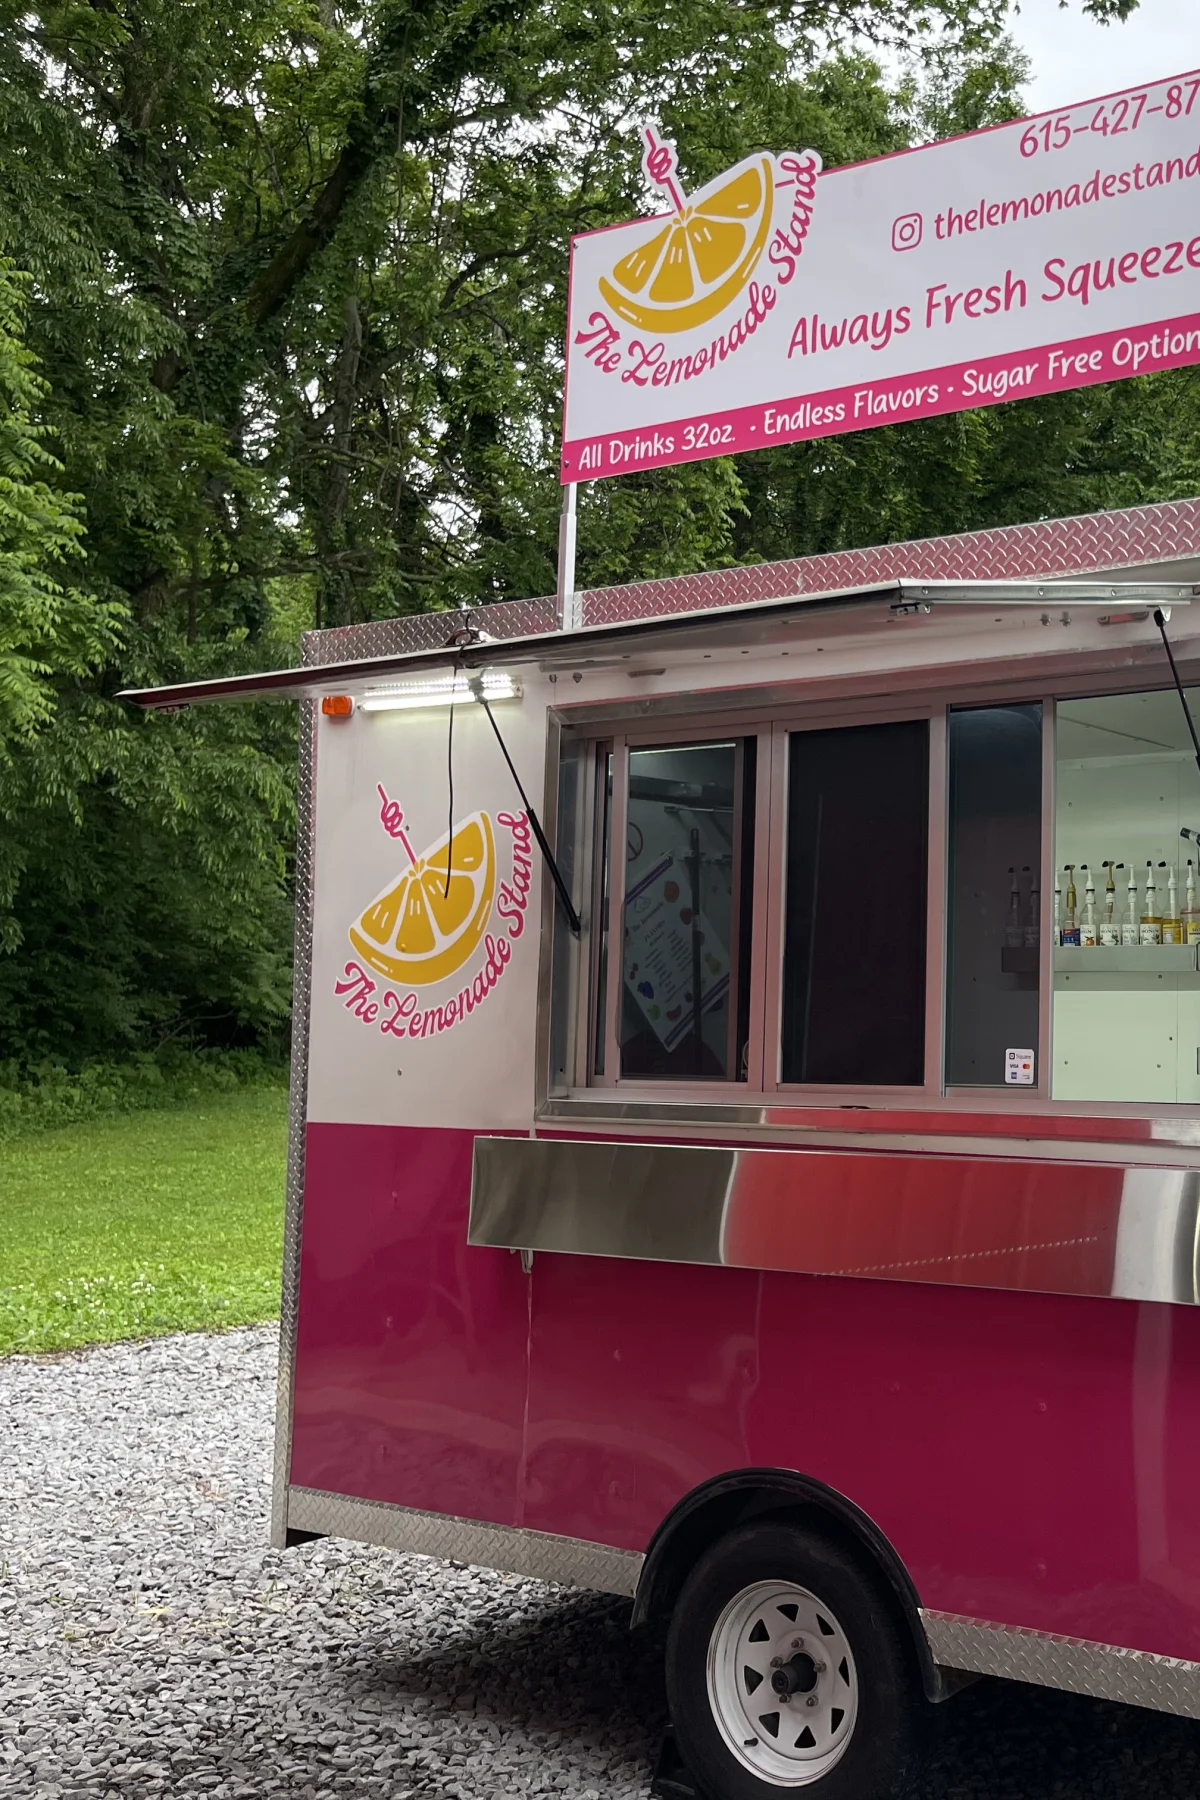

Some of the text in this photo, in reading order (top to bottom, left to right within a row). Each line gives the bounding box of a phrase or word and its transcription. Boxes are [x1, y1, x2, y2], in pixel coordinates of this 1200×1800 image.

[574, 156, 817, 387] The Lemonade Stand
[787, 304, 912, 359] Always
[925, 269, 1028, 329] Fresh
[578, 442, 602, 471] All
[609, 434, 675, 465] Drinks
[681, 422, 736, 451] 32oz.
[763, 402, 846, 435] Endless
[853, 384, 939, 418] Flavors
[962, 363, 1039, 398] Sugar
[1047, 349, 1103, 380] Free
[334, 811, 533, 1038] The Lemonade Stand
